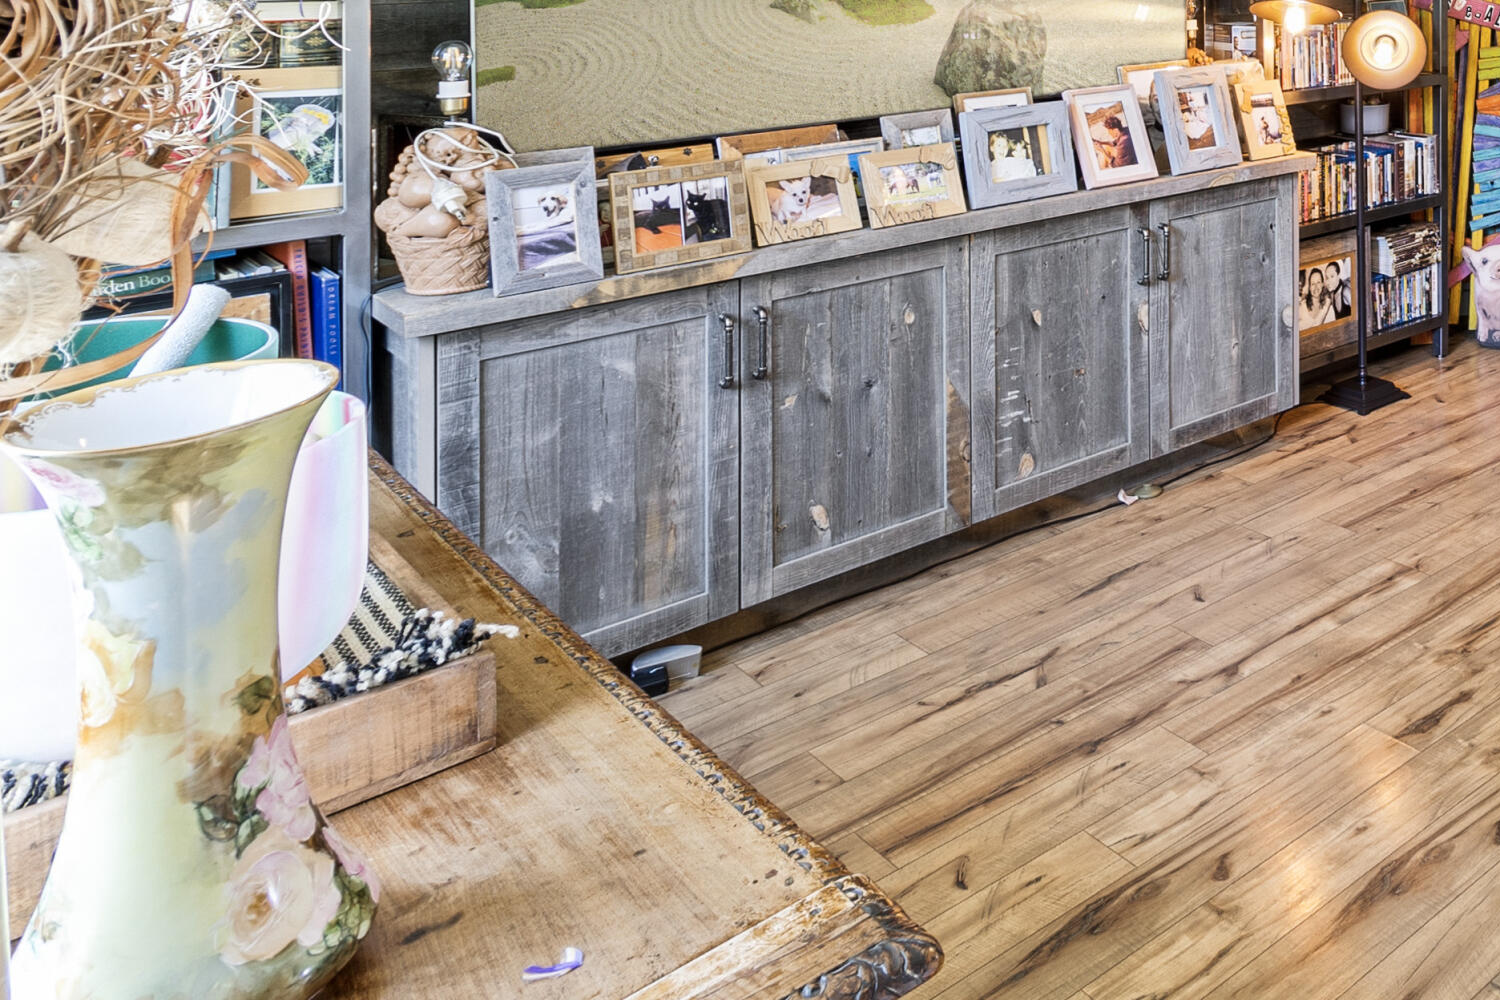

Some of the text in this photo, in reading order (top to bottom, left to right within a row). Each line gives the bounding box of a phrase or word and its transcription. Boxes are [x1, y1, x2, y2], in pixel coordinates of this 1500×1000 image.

[138, 274, 172, 288] Boo
[327, 286, 338, 356] DREAM POOLS
